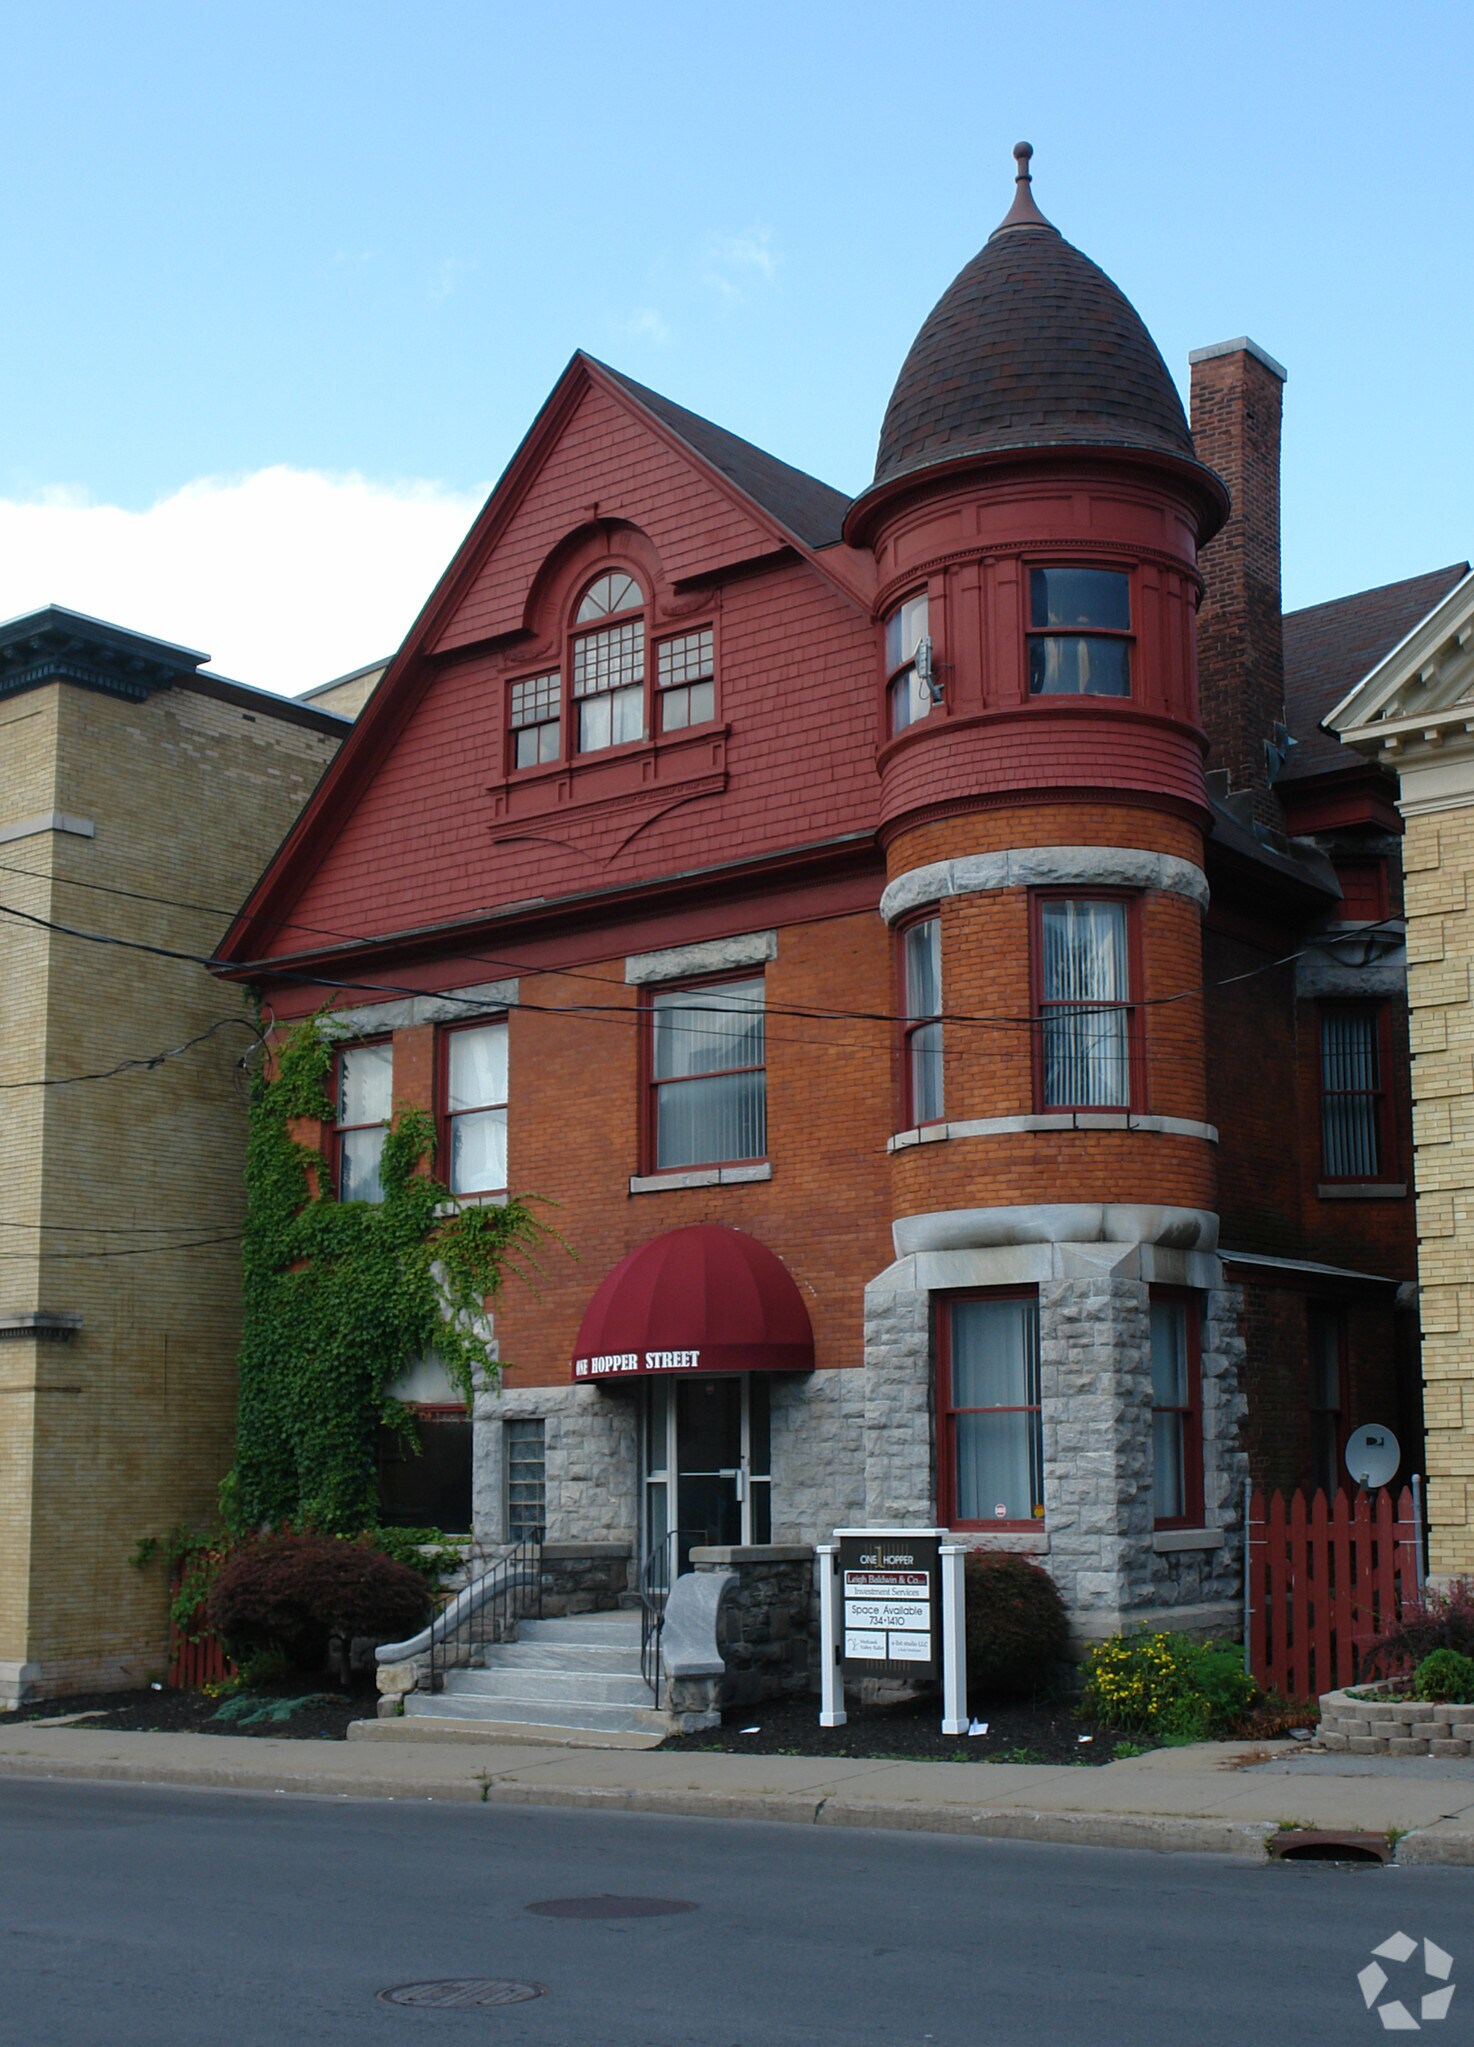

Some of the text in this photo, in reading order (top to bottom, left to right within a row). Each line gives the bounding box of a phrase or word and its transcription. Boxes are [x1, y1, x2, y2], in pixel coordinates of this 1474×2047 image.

[591, 1353, 638, 1374] HOPPER
[645, 1350, 700, 1369] STREET
[859, 1554, 877, 1565] ONE
[883, 1555, 914, 1565] HOPPER
[847, 1574, 867, 1585] Leigh
[868, 1574, 897, 1584] Baldwin
[899, 1575, 906, 1584] &
[854, 1587, 920, 1596] Investment Services
[851, 1604, 923, 1616] Space Available
